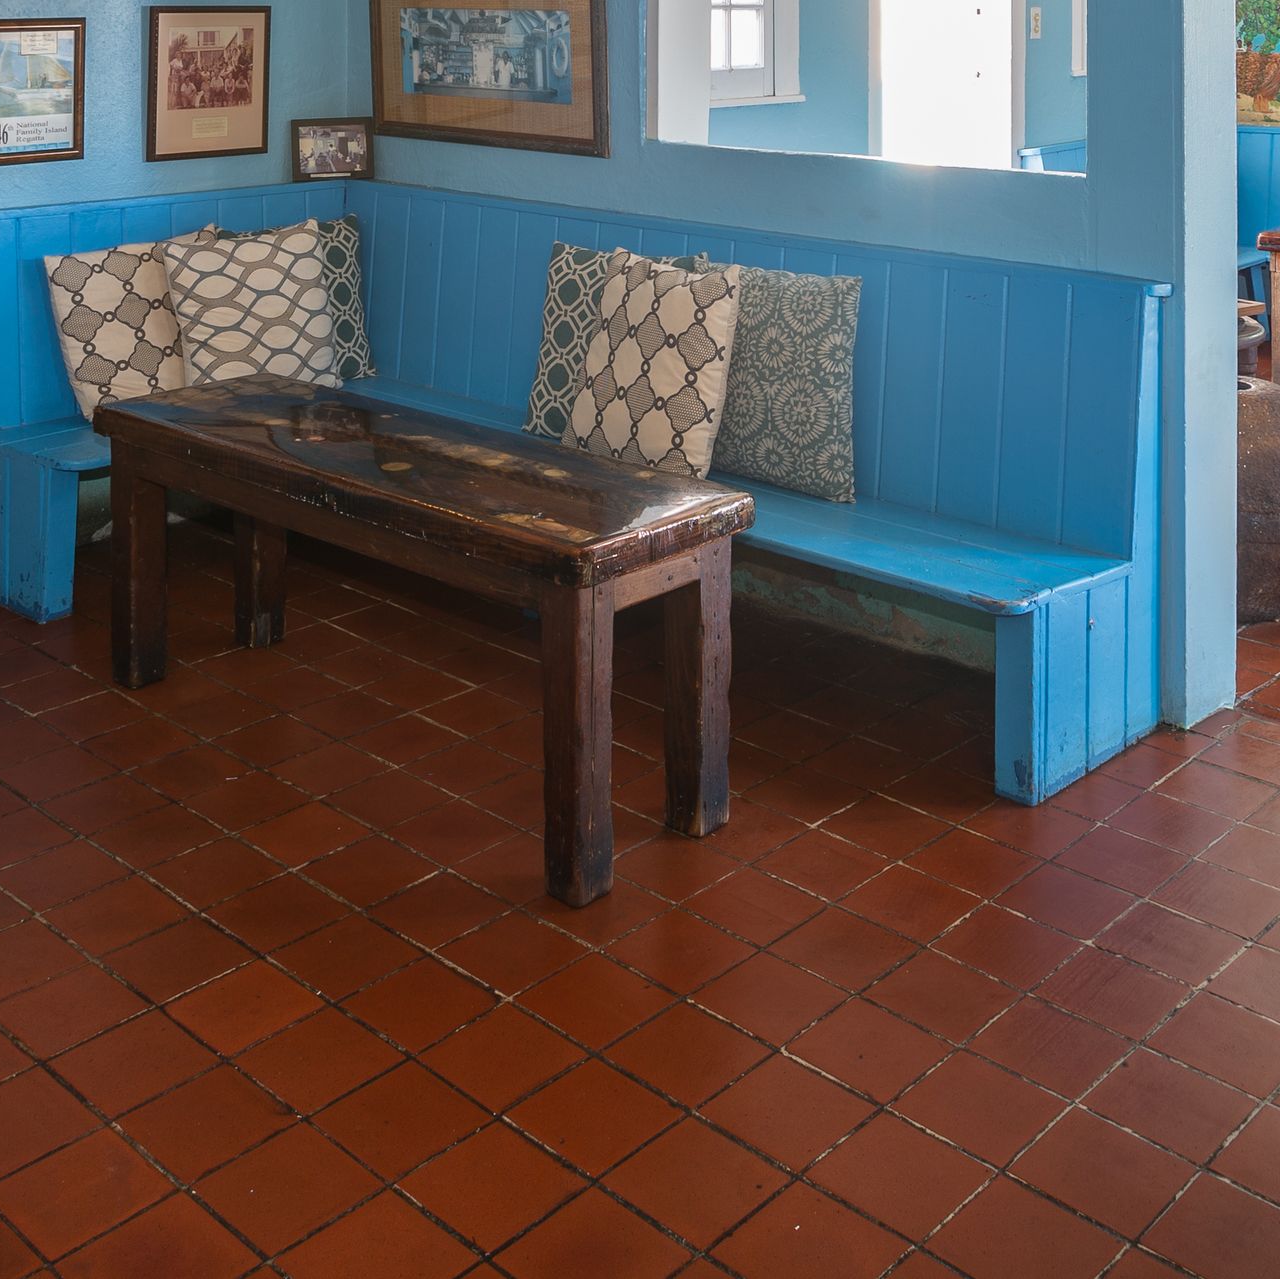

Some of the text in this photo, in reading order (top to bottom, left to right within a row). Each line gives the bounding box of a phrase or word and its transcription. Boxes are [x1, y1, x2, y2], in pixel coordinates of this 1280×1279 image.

[16, 120, 49, 129] National
[16, 126, 68, 136] Family Island
